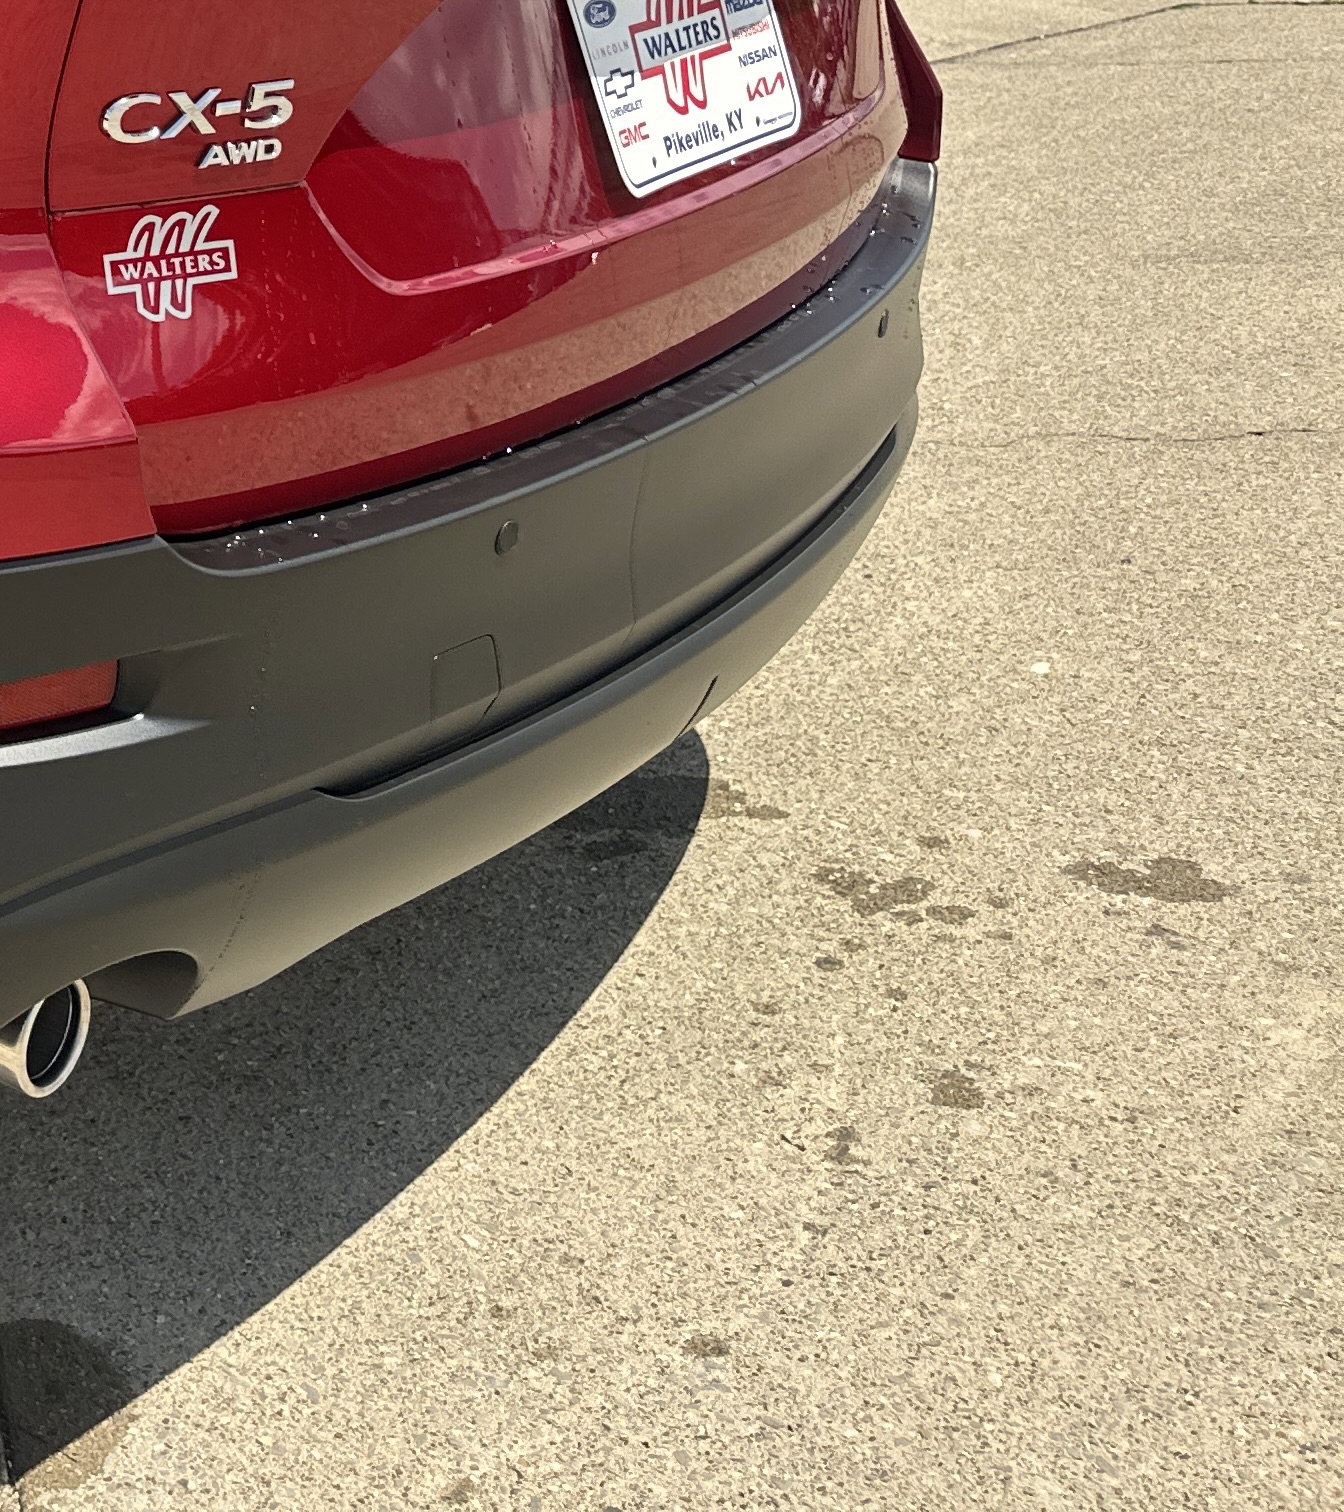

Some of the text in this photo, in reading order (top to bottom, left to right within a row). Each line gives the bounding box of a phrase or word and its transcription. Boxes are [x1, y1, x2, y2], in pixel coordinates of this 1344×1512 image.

[592, 40, 630, 61] LINCOLN
[643, 16, 722, 60] WALTERS
[738, 45, 778, 68] NISSAN
[100, 78, 295, 145] CX-5
[609, 99, 643, 119] CHEVROLET
[618, 121, 650, 148] GMC
[663, 120, 725, 158] Pikeville,
[725, 108, 745, 136] KY
[197, 137, 283, 170] AWD
[117, 251, 226, 281] WALTERS
